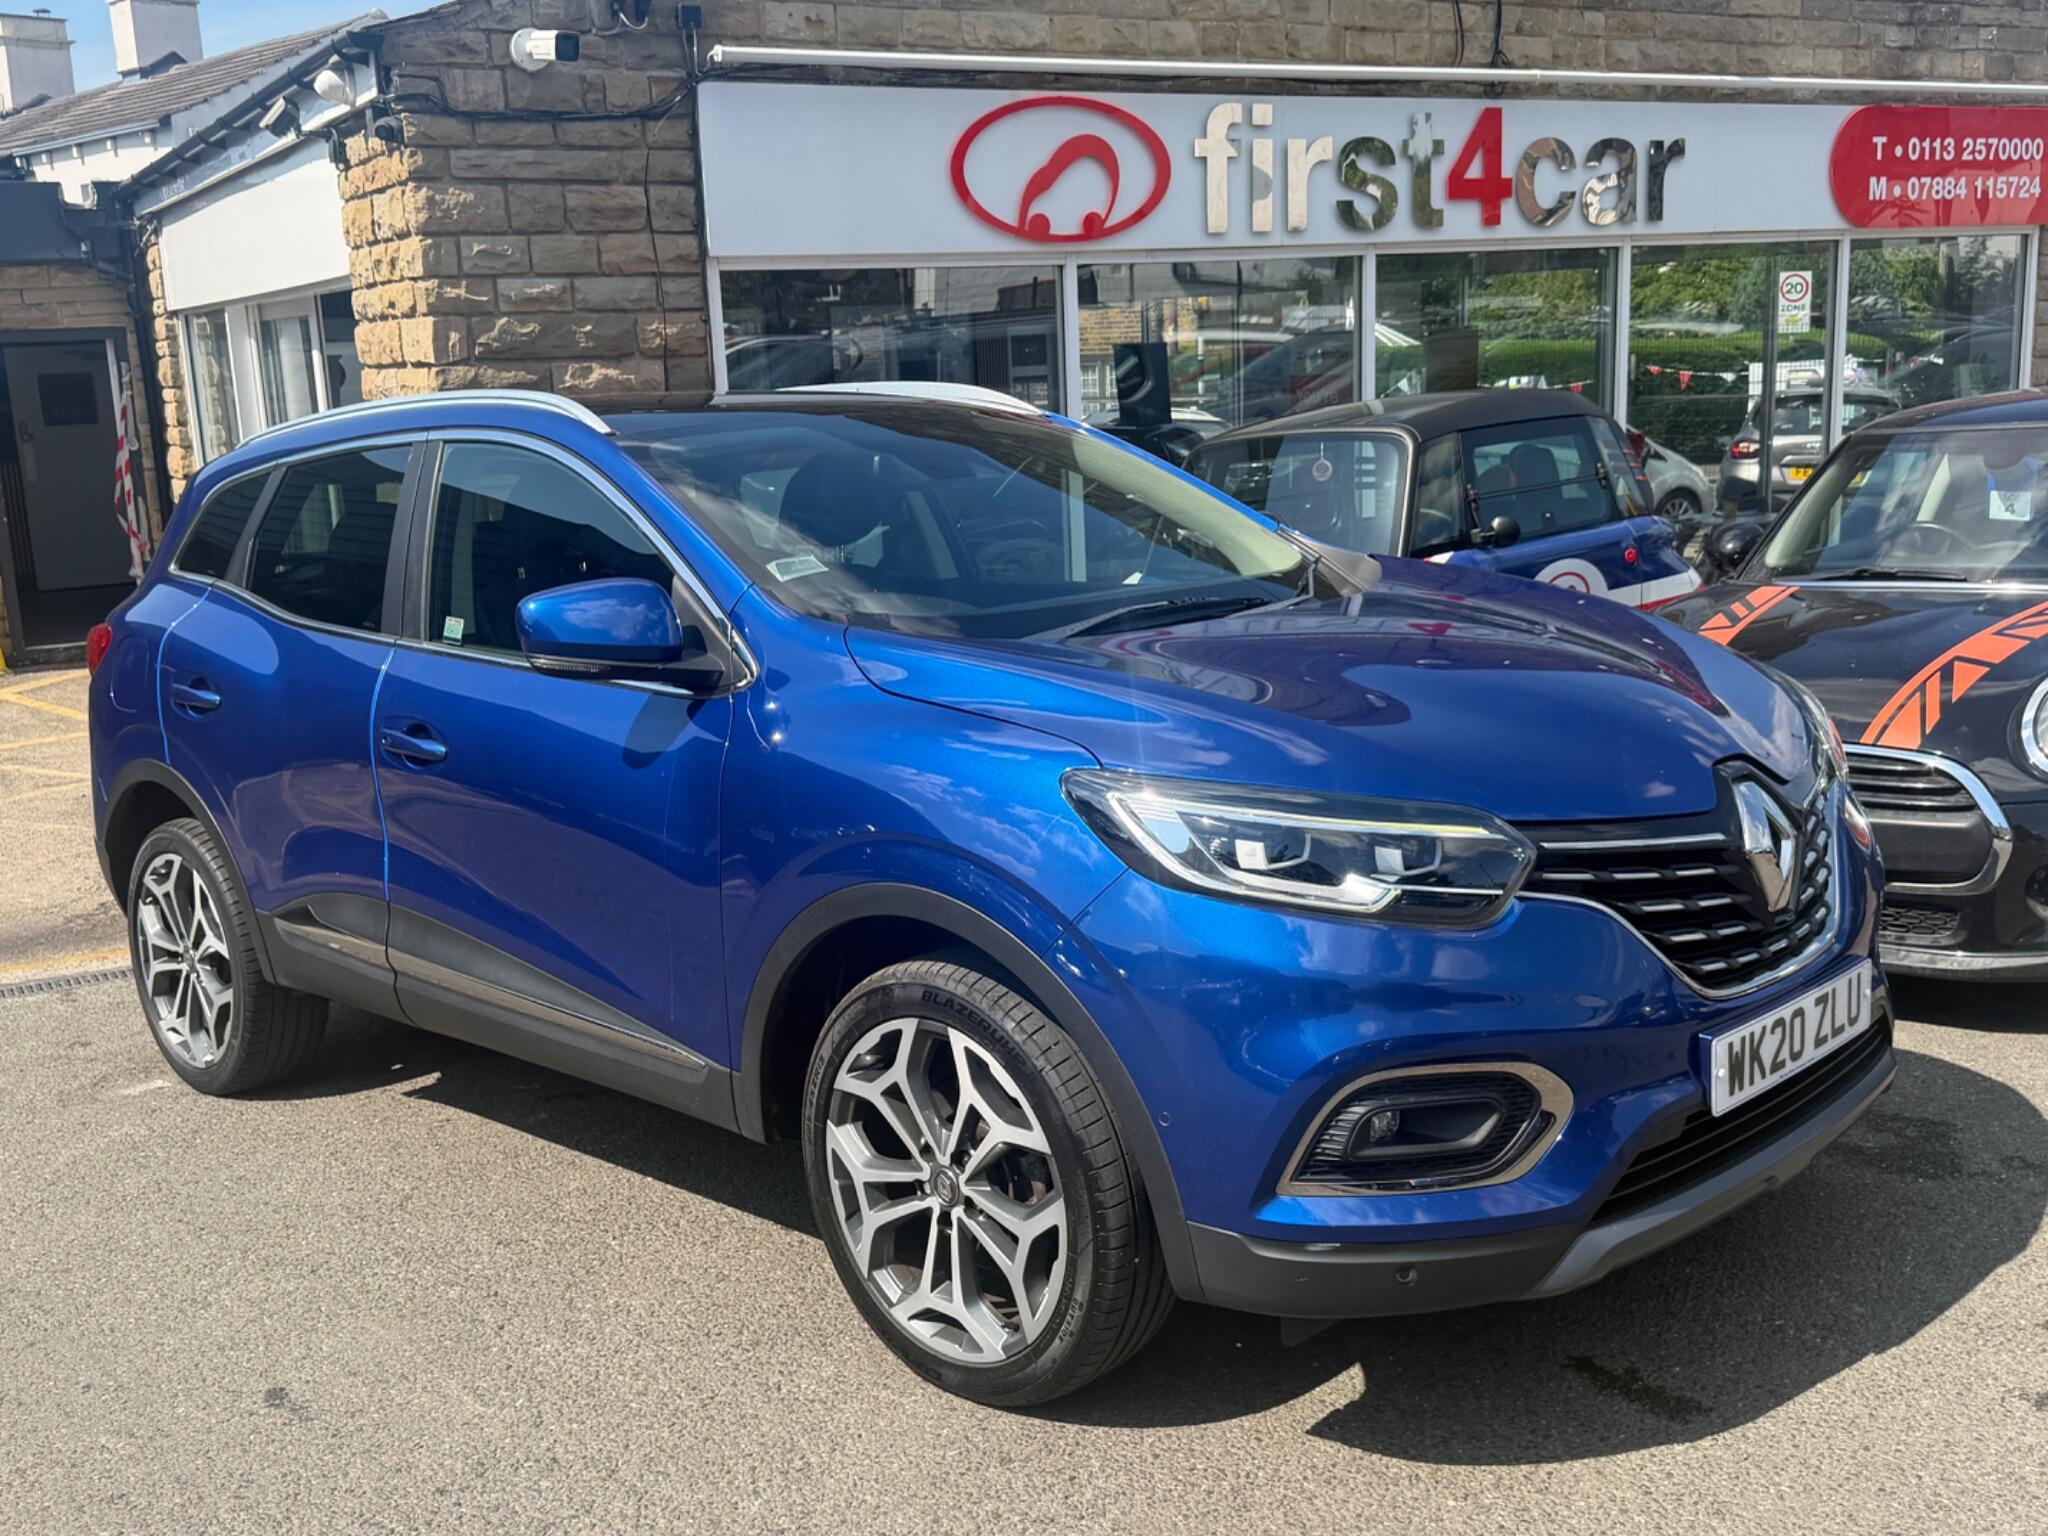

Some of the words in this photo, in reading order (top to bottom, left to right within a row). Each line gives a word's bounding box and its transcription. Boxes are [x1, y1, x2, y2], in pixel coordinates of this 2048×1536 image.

[1908, 137, 1955, 161] 0113
[1962, 137, 2044, 161] 2570000
[1194, 102, 1686, 234] first4car
[1907, 176, 1967, 201] 07884
[1974, 175, 2042, 199] 115724
[1785, 282, 1804, 295] 20
[1727, 1006, 1806, 1097] WK20
[1813, 971, 1862, 1050] ZLU
